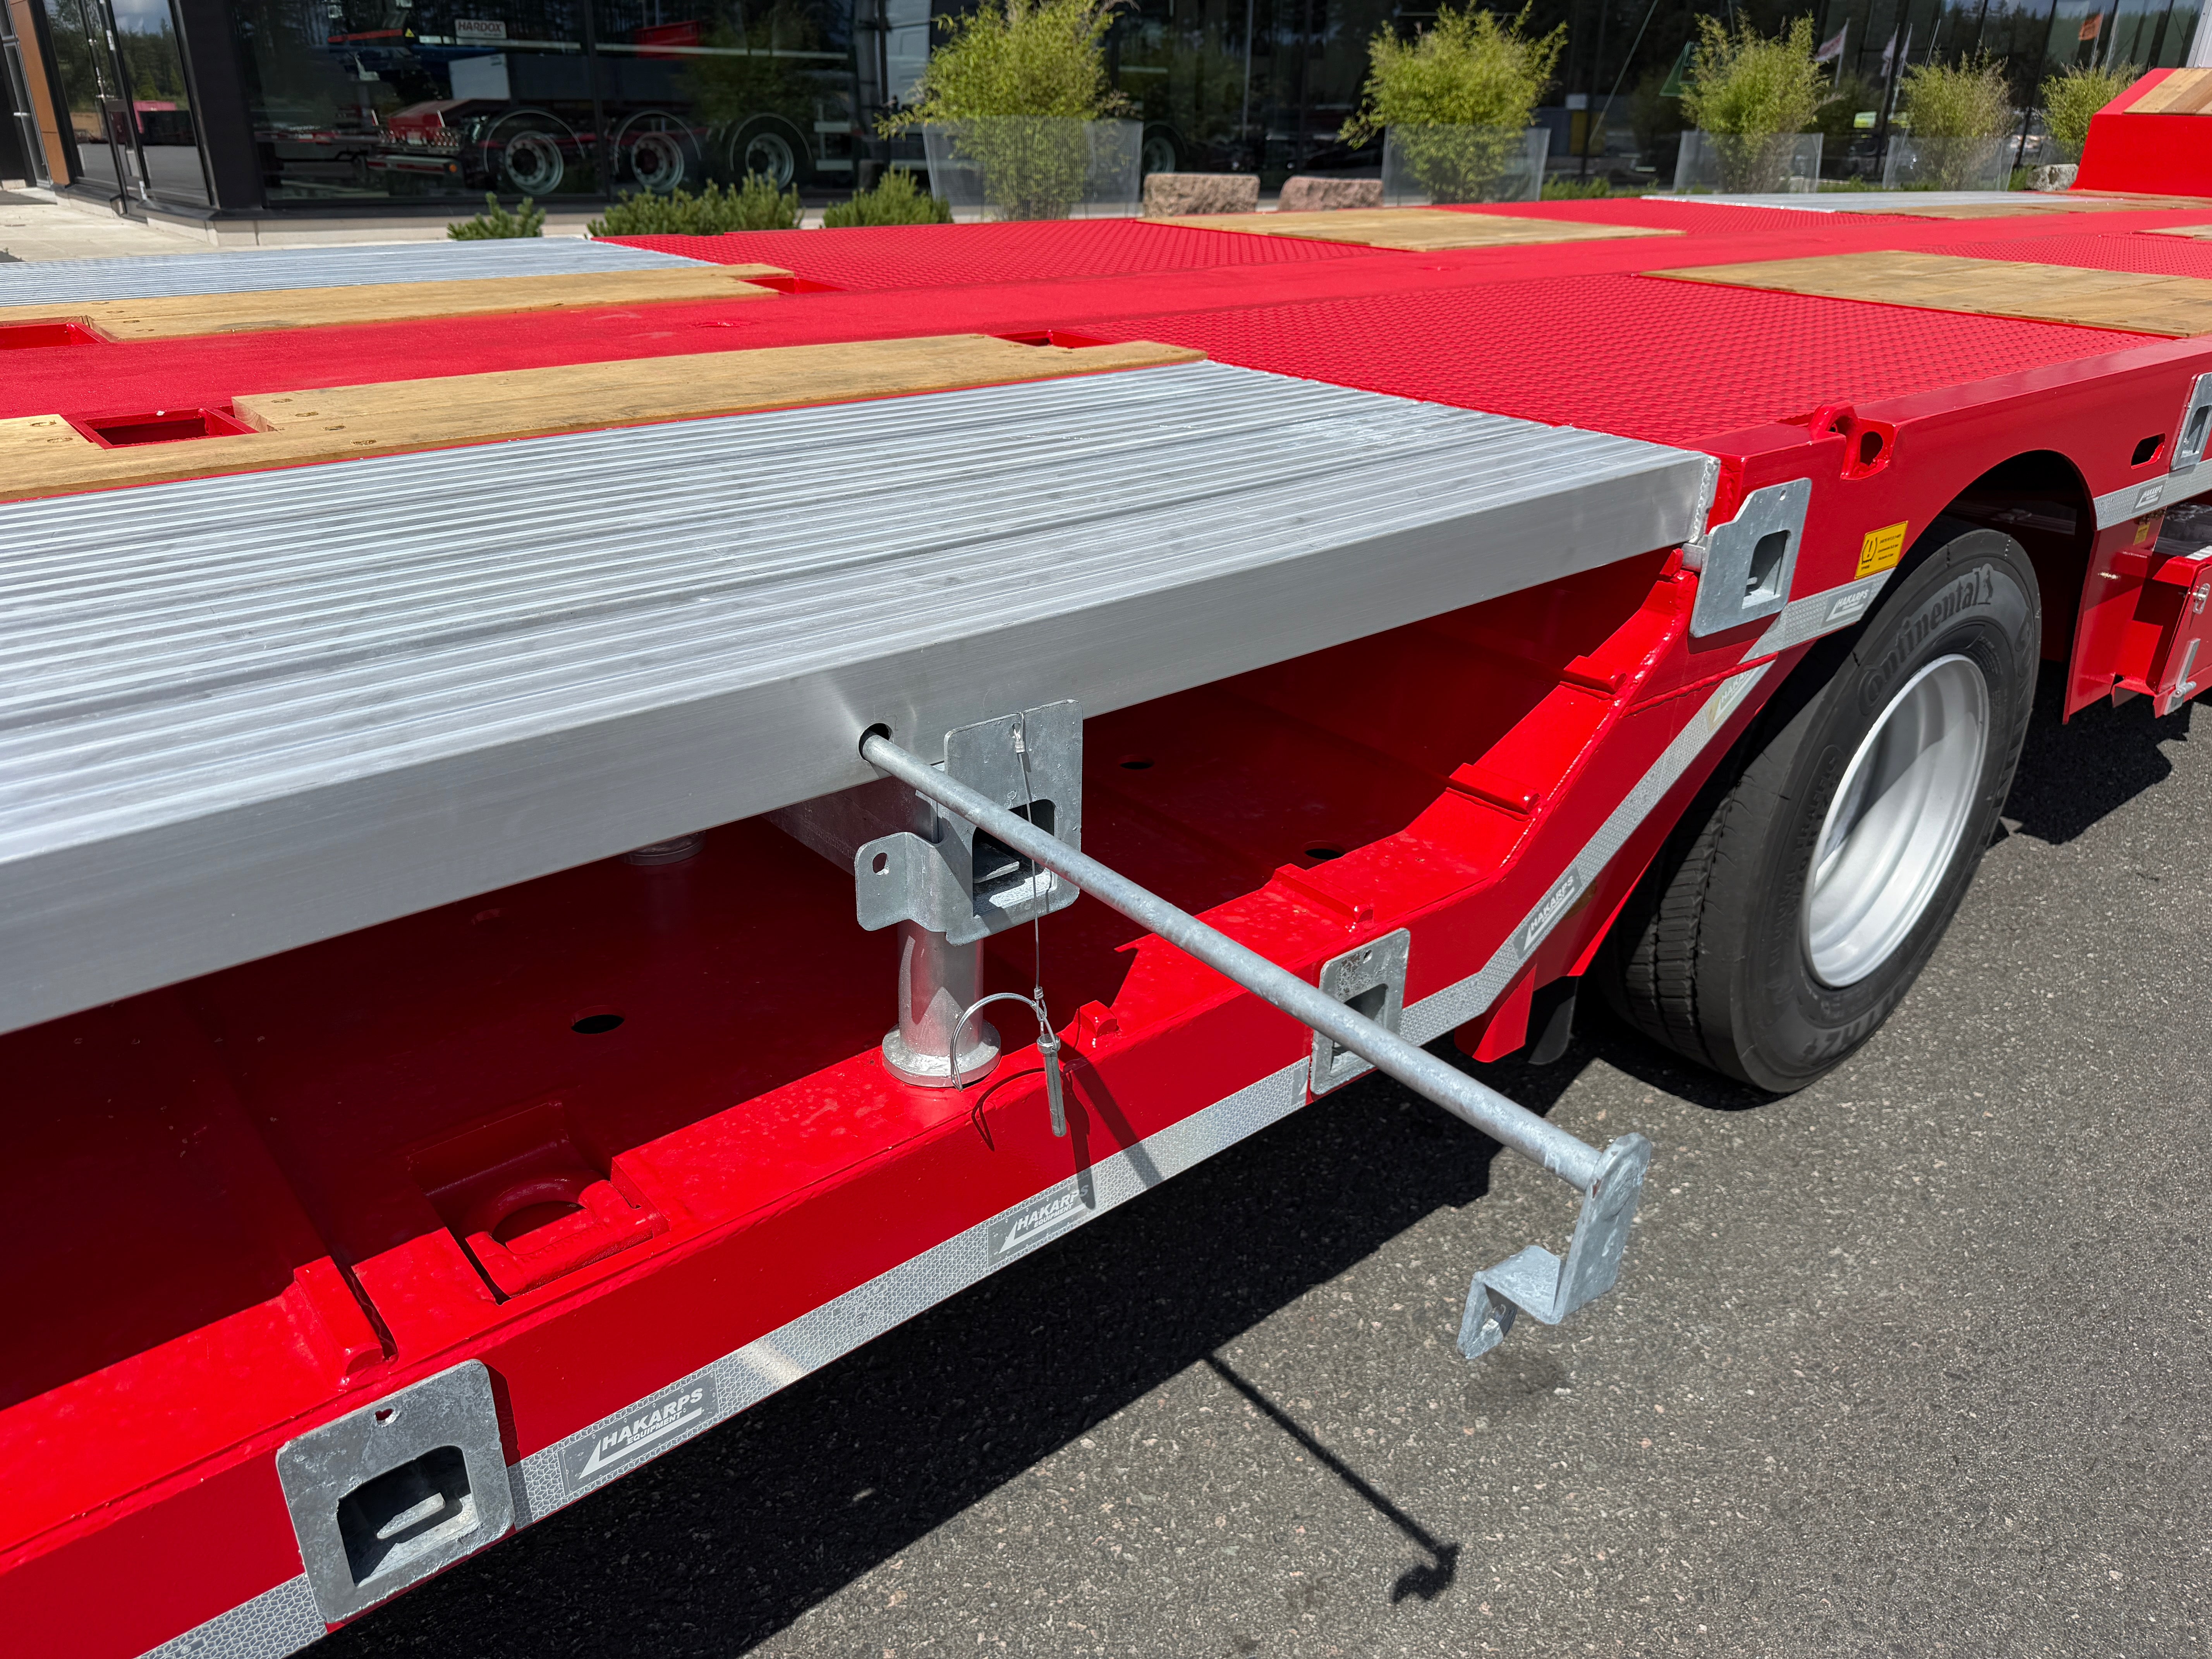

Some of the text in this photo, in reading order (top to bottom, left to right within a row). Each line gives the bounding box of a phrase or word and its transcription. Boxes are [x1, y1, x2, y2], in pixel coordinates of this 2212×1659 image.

[458, 21, 501, 32] HARDOX
[1836, 589, 1869, 608] HAKARPS
[1858, 571, 1980, 716] Continental
[1530, 875, 1573, 931] HAKARPS
[1017, 1185, 1089, 1231] HAKARPS
[1034, 1203, 1073, 1228] EQUIPMENT
[602, 1388, 703, 1451] HAKARPS
[627, 1411, 682, 1444] EQUIPMENT
